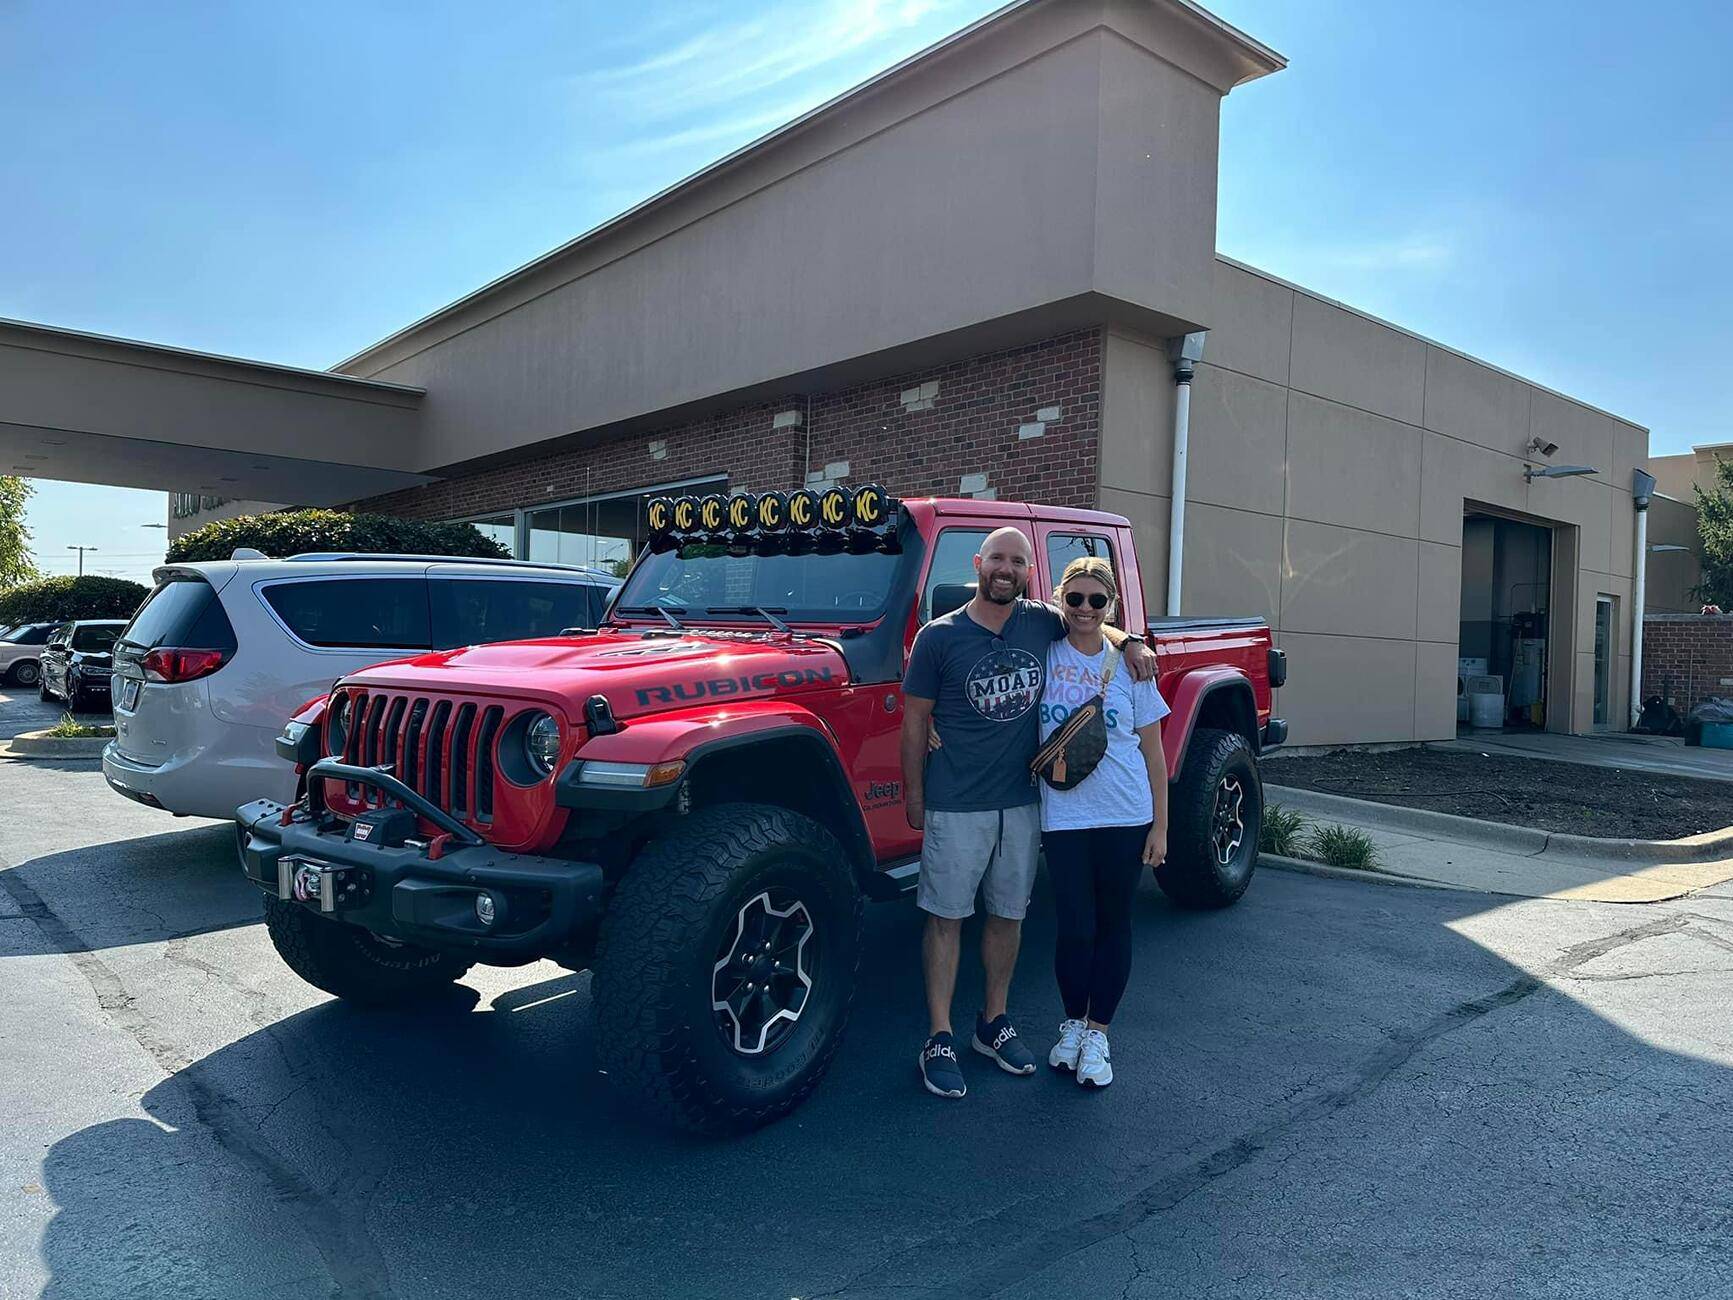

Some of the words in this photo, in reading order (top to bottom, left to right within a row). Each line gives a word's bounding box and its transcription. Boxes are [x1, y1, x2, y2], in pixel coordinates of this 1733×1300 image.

[649, 503, 666, 530] KC
[675, 501, 692, 529] KC
[702, 500, 719, 528] KC
[730, 499, 748, 527] KC
[760, 496, 779, 526] KC
[790, 494, 811, 525] KC
[822, 493, 844, 523] KC
[856, 490, 878, 522] KC
[635, 667, 832, 706] RUBICON
[973, 670, 1040, 697] MOAB
[1040, 703, 1119, 729] BOS
[864, 781, 900, 800] Jeep
